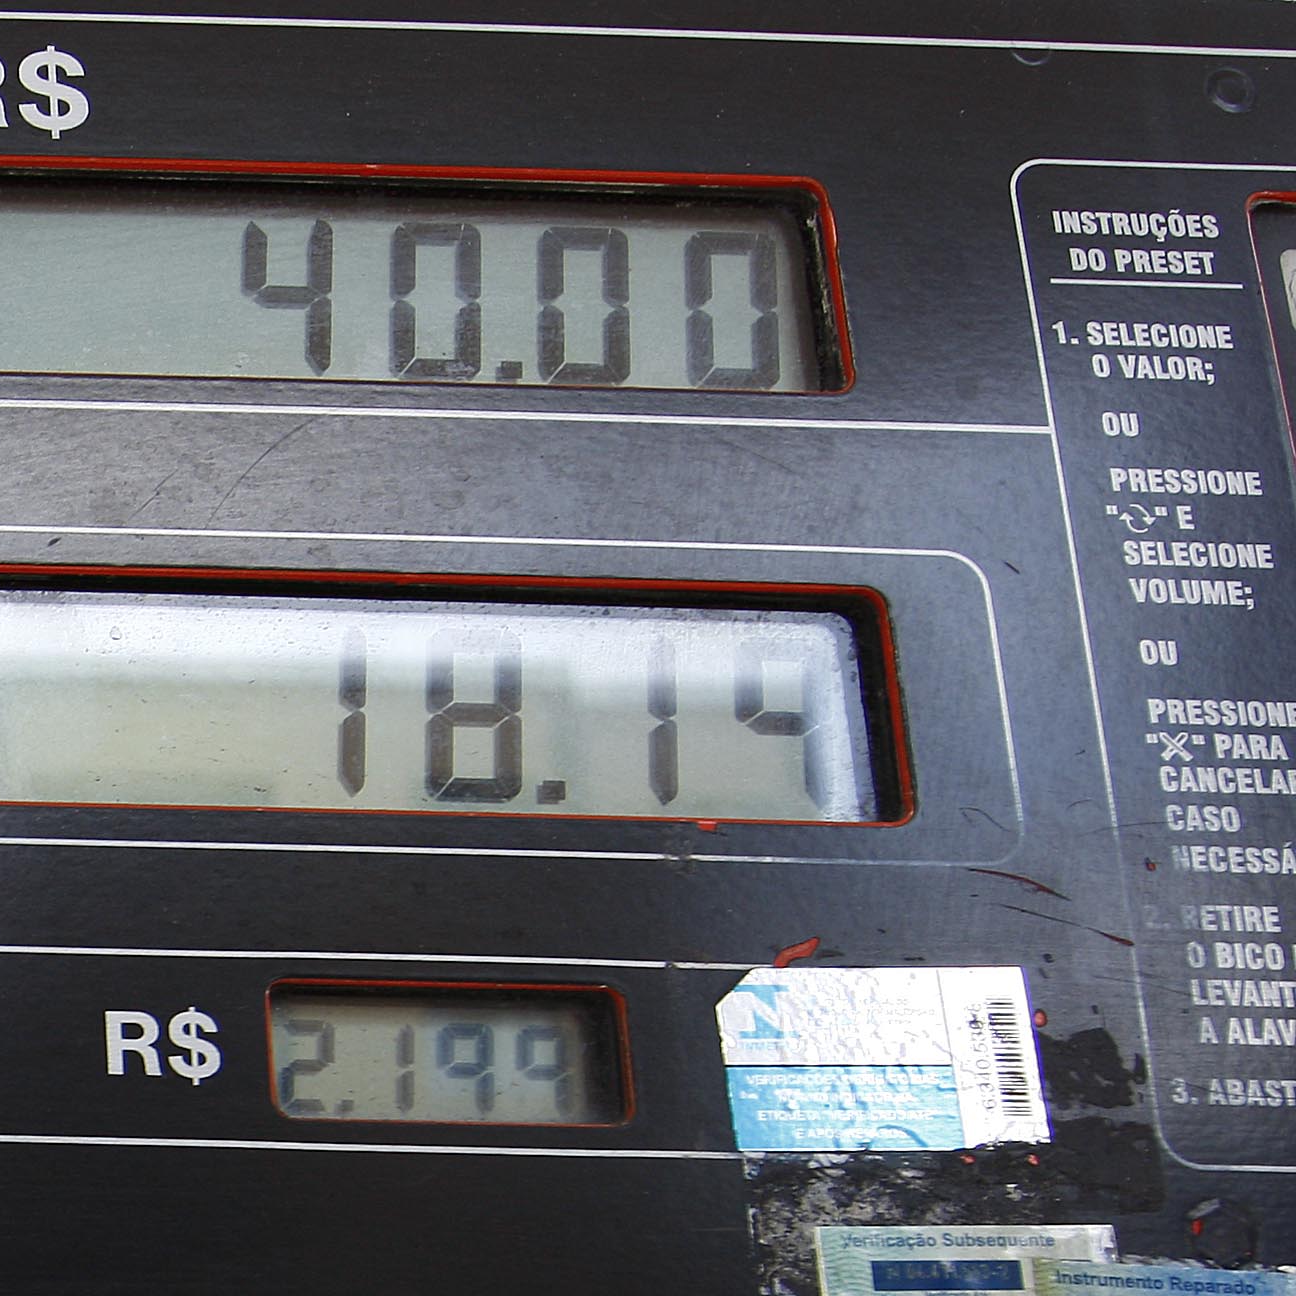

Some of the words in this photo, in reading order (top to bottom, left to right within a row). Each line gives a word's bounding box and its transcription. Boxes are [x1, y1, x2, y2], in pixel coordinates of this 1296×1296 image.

[1051, 208, 1220, 242] INSTRUÇÕES
[1068, 247, 1107, 273] DO
[1114, 248, 1216, 276] PRESET
[242, 217, 782, 391] 40.00
[1051, 320, 1080, 346] 1.
[1086, 321, 1234, 350] SELECIONE
[1092, 353, 1111, 379] O
[1116, 354, 1216, 385] VALOR;
[1101, 411, 1140, 438] OU
[1109, 467, 1263, 496] PRESSIONE
[1176, 505, 1196, 530] E
[1123, 540, 1275, 570] SELECIONE
[1128, 577, 1256, 610] VOLUME;
[1139, 639, 1179, 666] OU
[1213, 732, 1290, 762] PARA
[1165, 803, 1242, 833] CASO
[1180, 904, 1282, 933] RETIRE
[1186, 940, 1206, 969] O
[1213, 941, 1286, 971] BICO
[1200, 1016, 1219, 1044] A
[104, 1006, 222, 1086] R$
[279, 1018, 574, 1114] 2.199
[1171, 1077, 1200, 1105] 3.
[841, 1232, 937, 1250] Verificação
[941, 1232, 1056, 1249] Subsequente
[1055, 1269, 1164, 1291] Instrumento
[1169, 1275, 1256, 1296] Reparado
